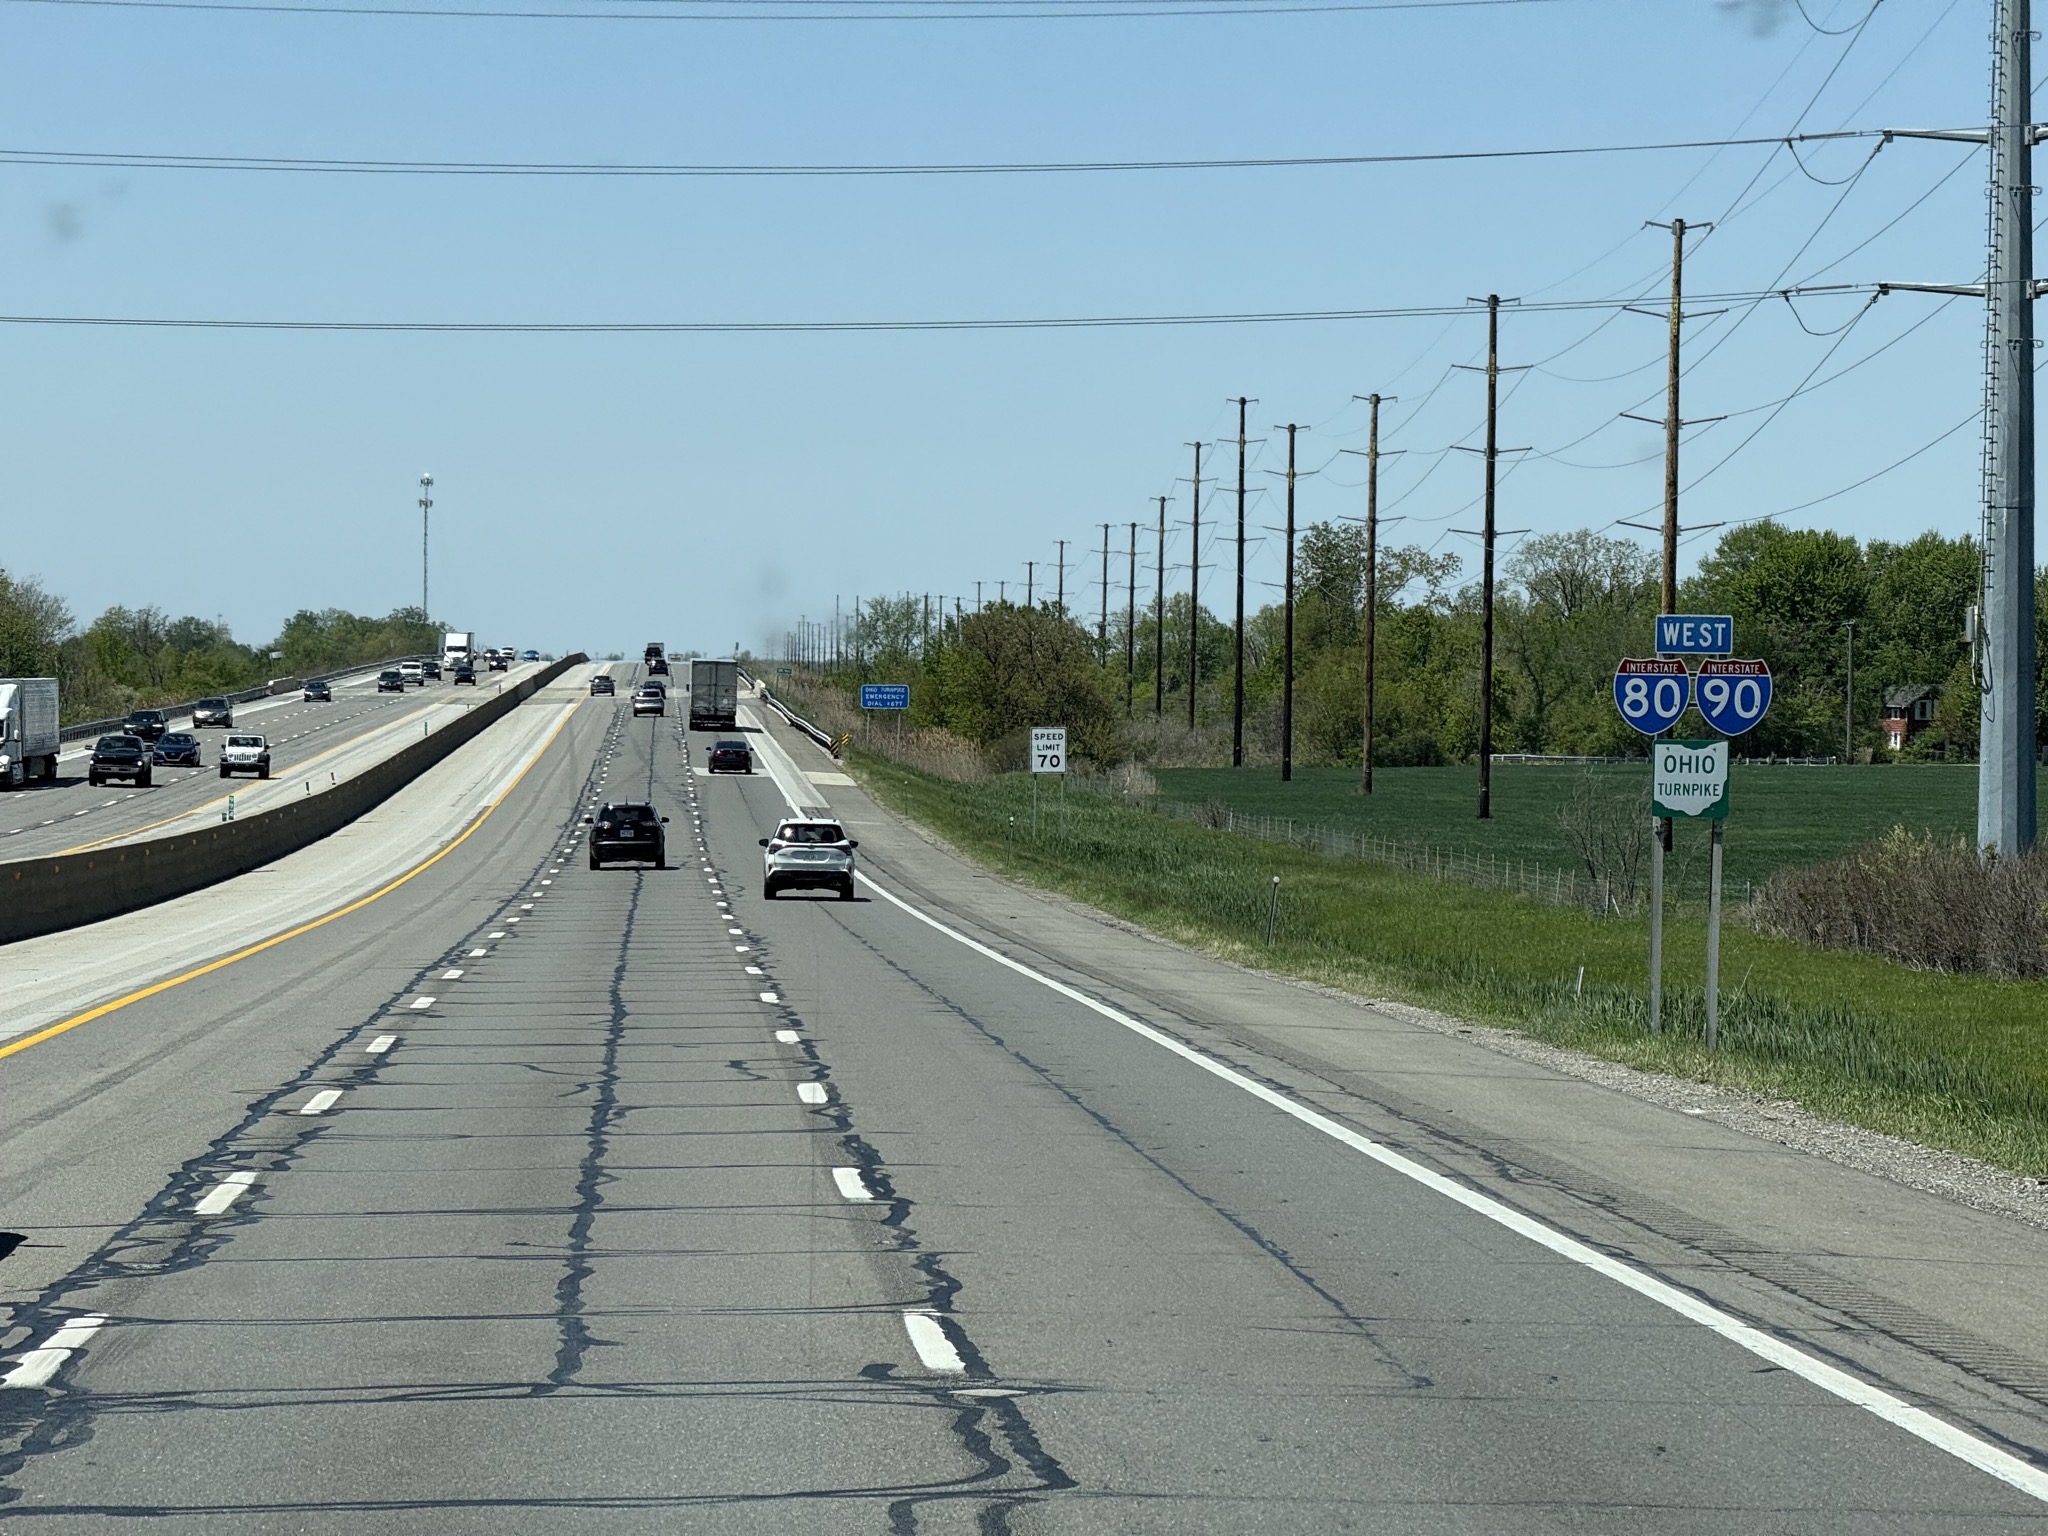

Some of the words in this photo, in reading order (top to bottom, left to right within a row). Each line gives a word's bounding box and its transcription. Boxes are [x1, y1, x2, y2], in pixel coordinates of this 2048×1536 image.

[1663, 623, 1726, 647] WEST
[1626, 664, 1679, 673] INTERSTATE
[1707, 664, 1760, 674] INTERSTATE
[1623, 678, 1681, 718] 80
[1703, 679, 1761, 719] 90
[1037, 754, 1060, 768] 70
[1664, 755, 1715, 774] OHIO
[1657, 783, 1720, 796] TURNPIKE
